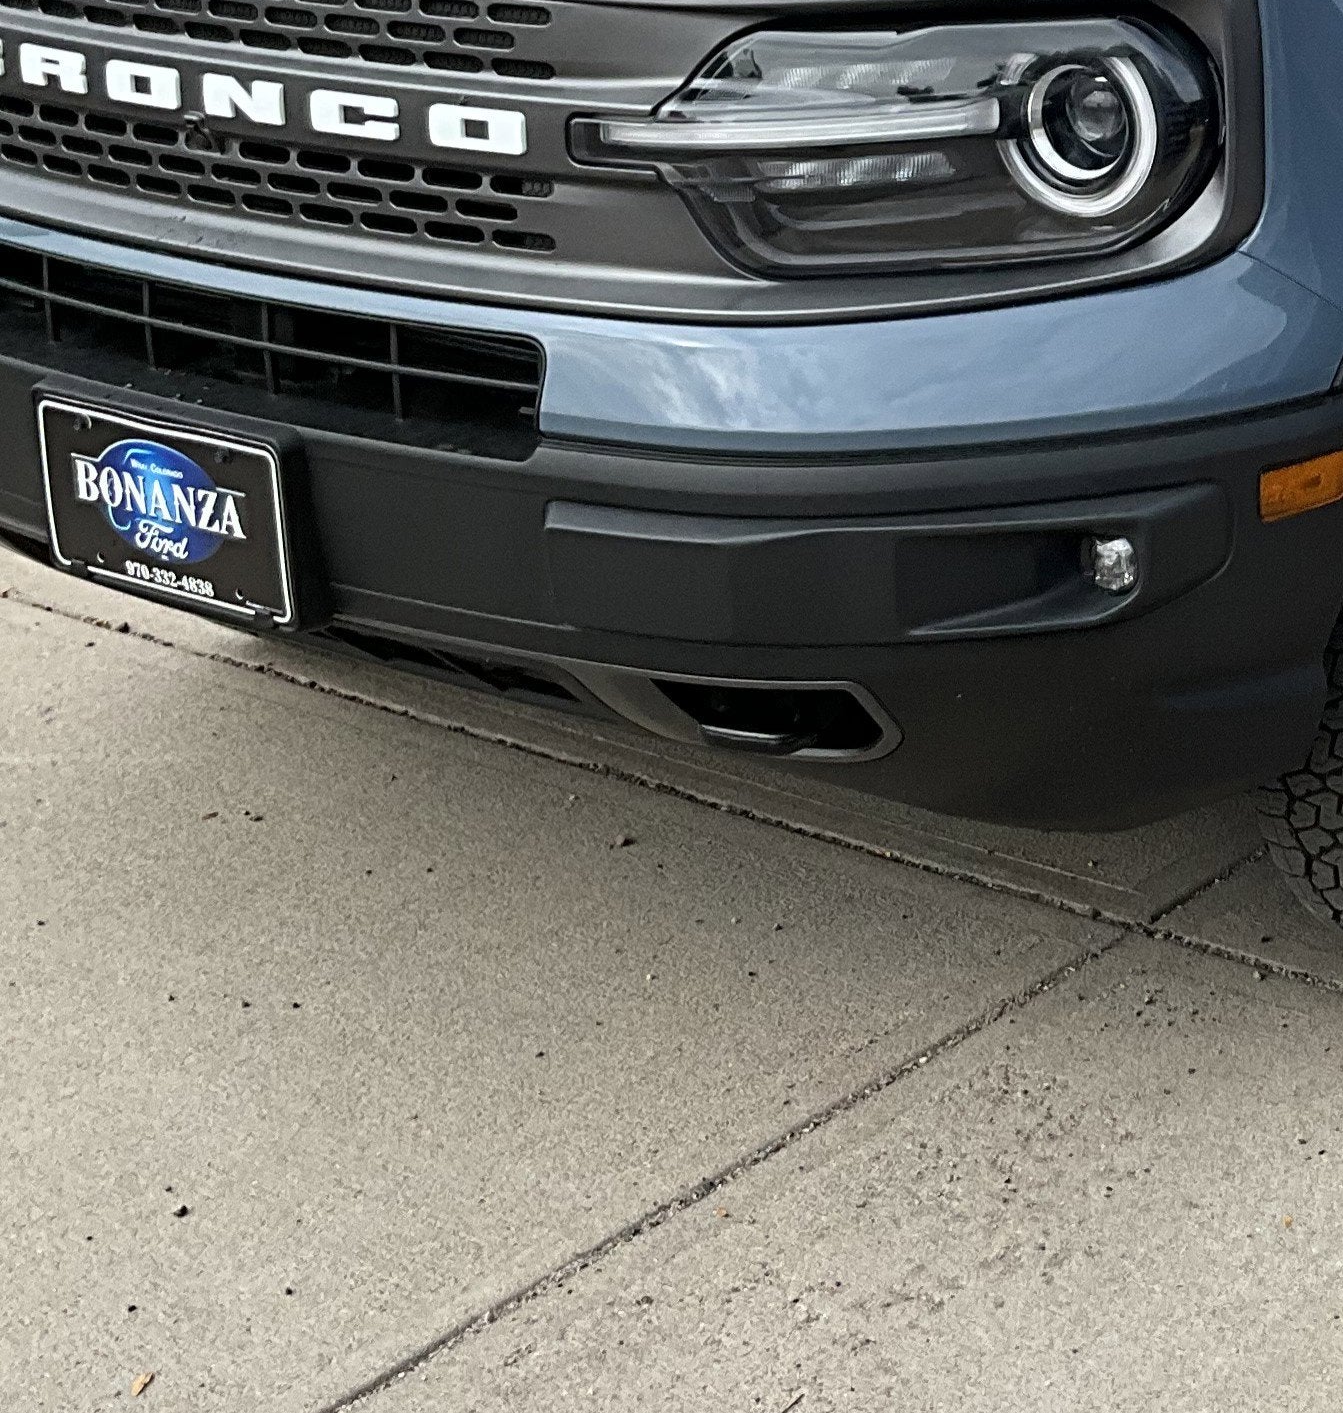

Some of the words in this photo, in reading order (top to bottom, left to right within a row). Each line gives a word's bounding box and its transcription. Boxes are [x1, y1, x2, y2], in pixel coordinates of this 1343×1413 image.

[0, 39, 528, 156] RONCO
[74, 458, 247, 539] BONANZA
[134, 518, 189, 559] Ford
[125, 559, 215, 598] 970-332-4838
